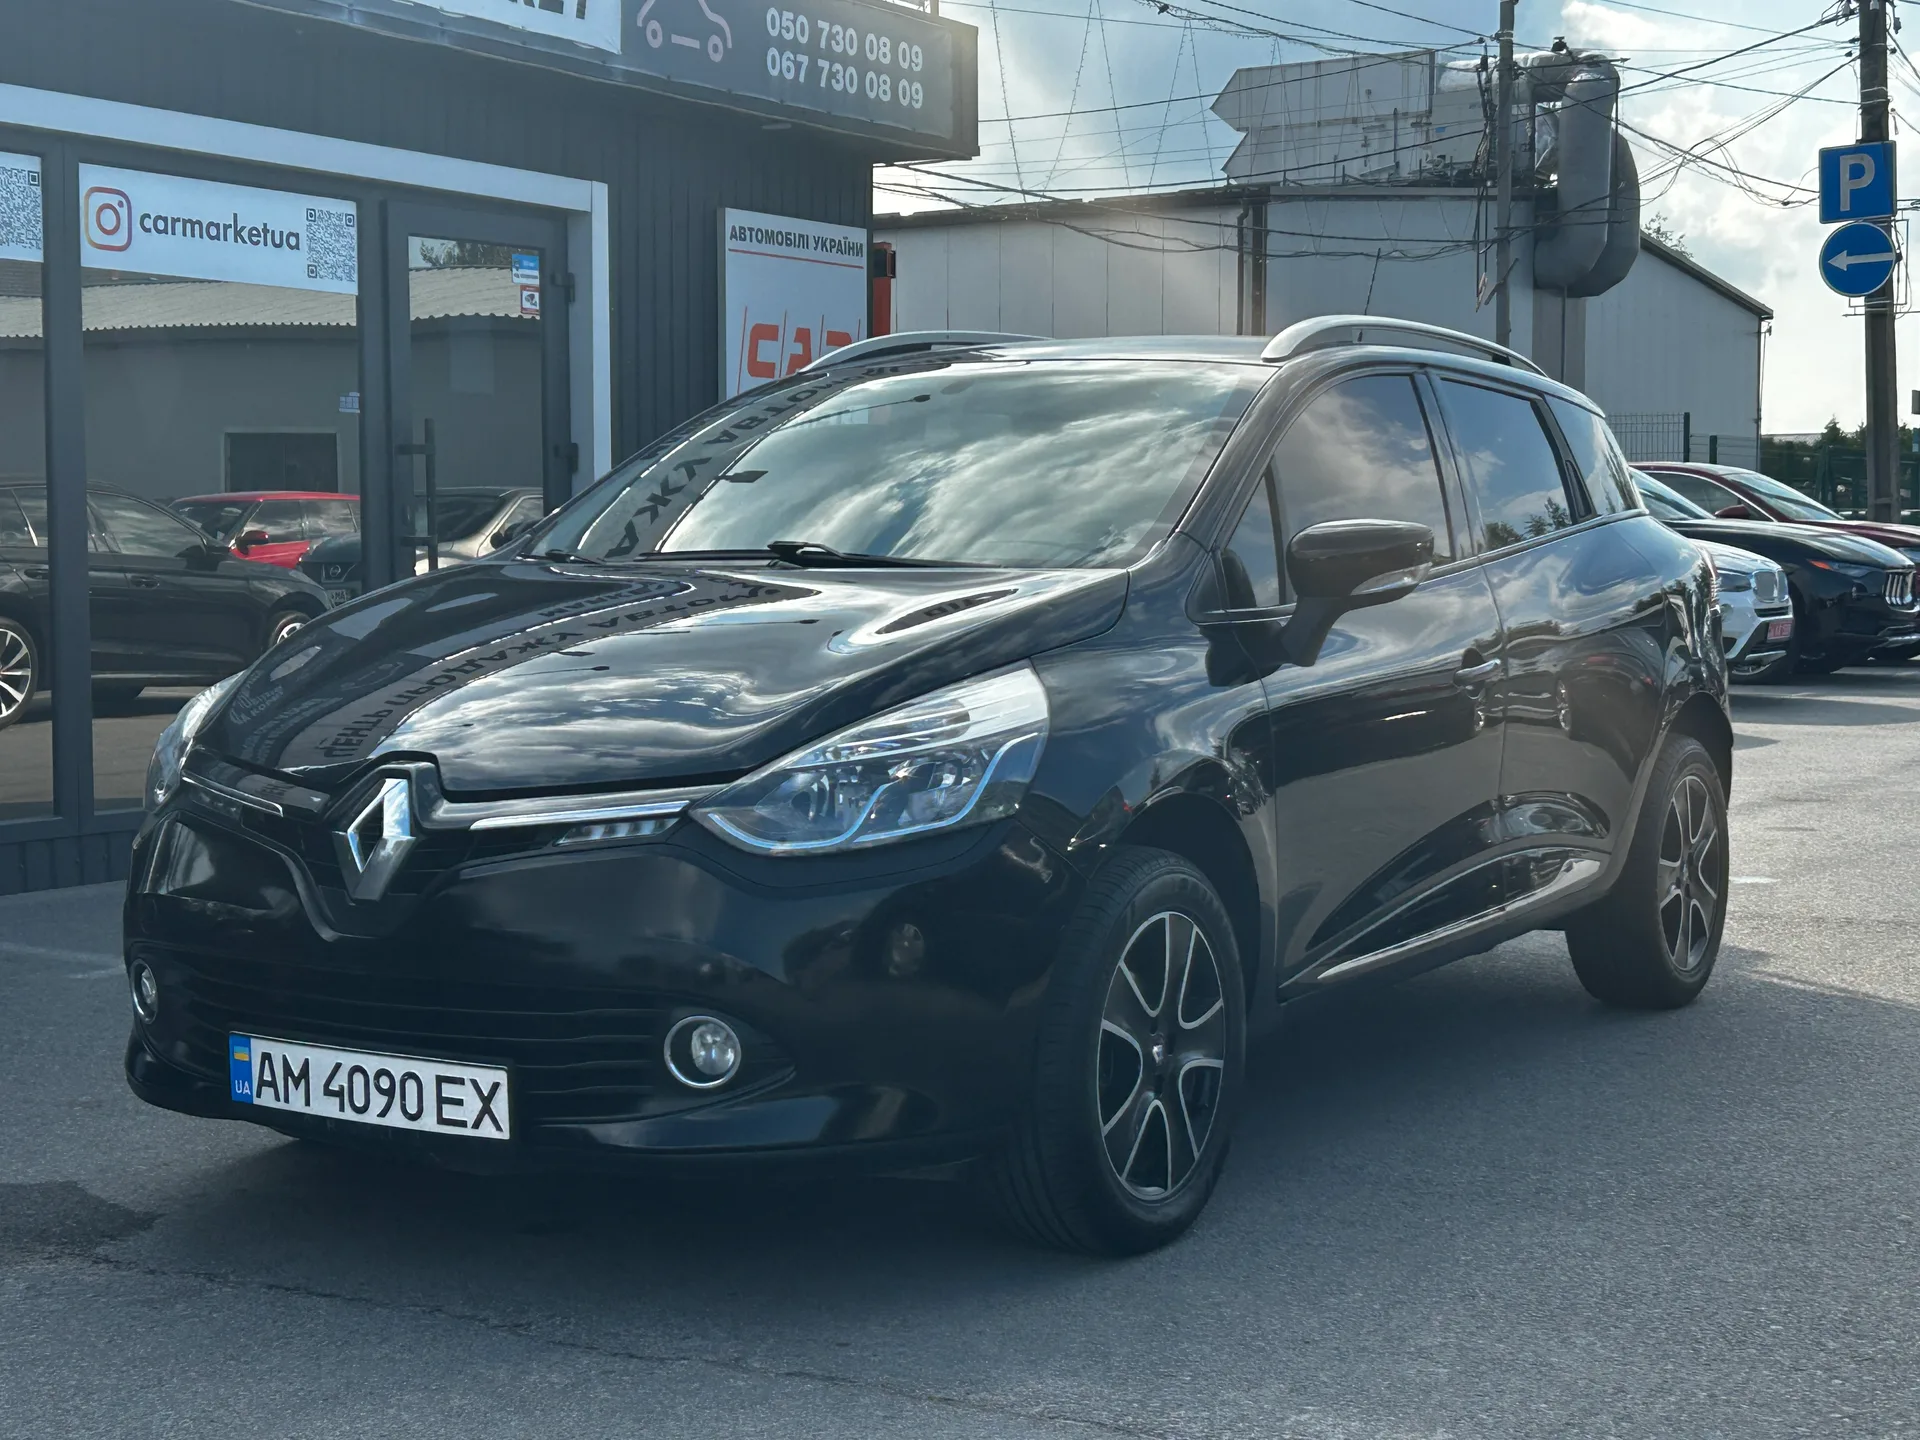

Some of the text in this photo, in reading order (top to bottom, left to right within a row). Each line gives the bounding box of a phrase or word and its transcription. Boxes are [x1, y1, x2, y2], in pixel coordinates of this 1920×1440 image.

[766, 7, 923, 72] 050 730 08 09
[766, 47, 923, 109] 067 730 08 09
[1840, 153, 1876, 212] P
[139, 213, 300, 251] carmarketua
[729, 225, 865, 258] АВТОМОБІЛІ УКРАЇНИ
[235, 1079, 251, 1096] UA
[256, 1051, 311, 1107] AM
[323, 1062, 424, 1122] 4090
[436, 1074, 504, 1133] EX
